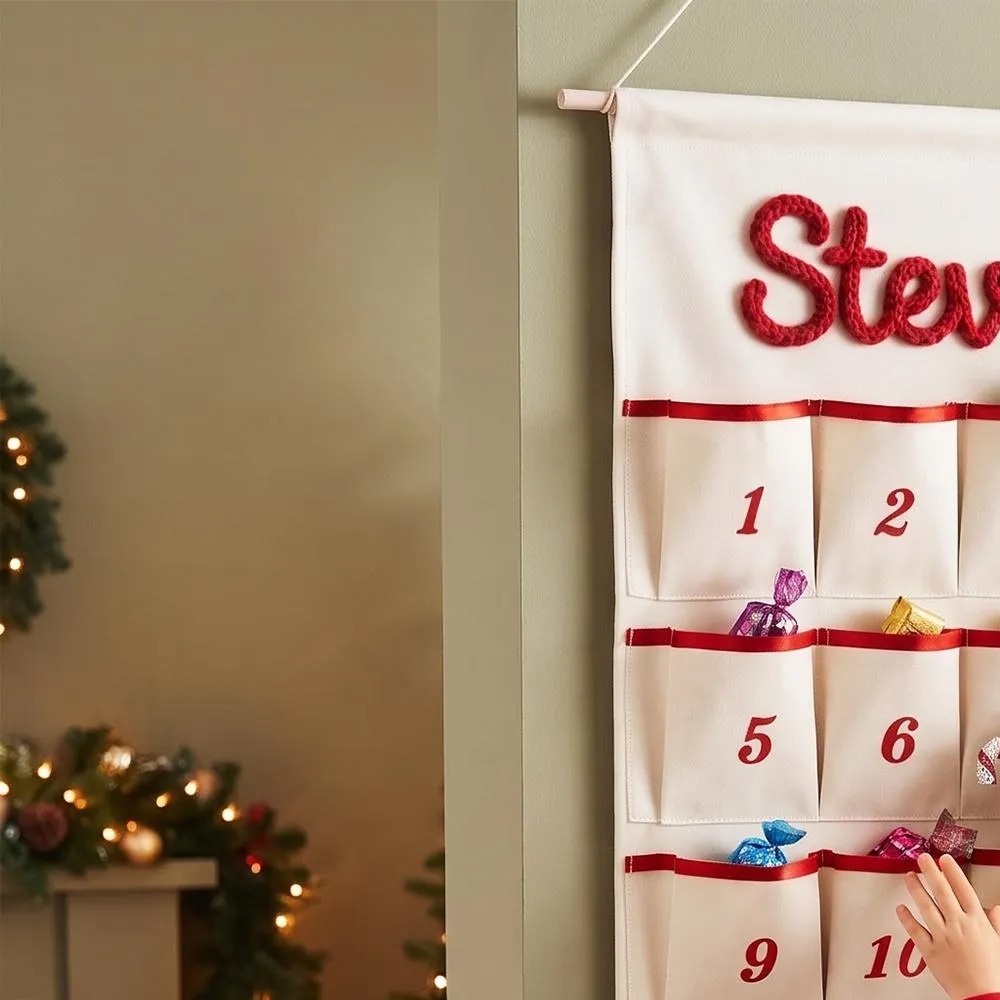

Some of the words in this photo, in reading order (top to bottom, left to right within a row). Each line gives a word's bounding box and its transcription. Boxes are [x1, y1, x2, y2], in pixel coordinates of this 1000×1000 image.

[736, 487, 764, 534] 1
[874, 489, 915, 536] 2
[738, 716, 777, 764] 5
[881, 717, 919, 763] 6
[740, 938, 779, 983] 9
